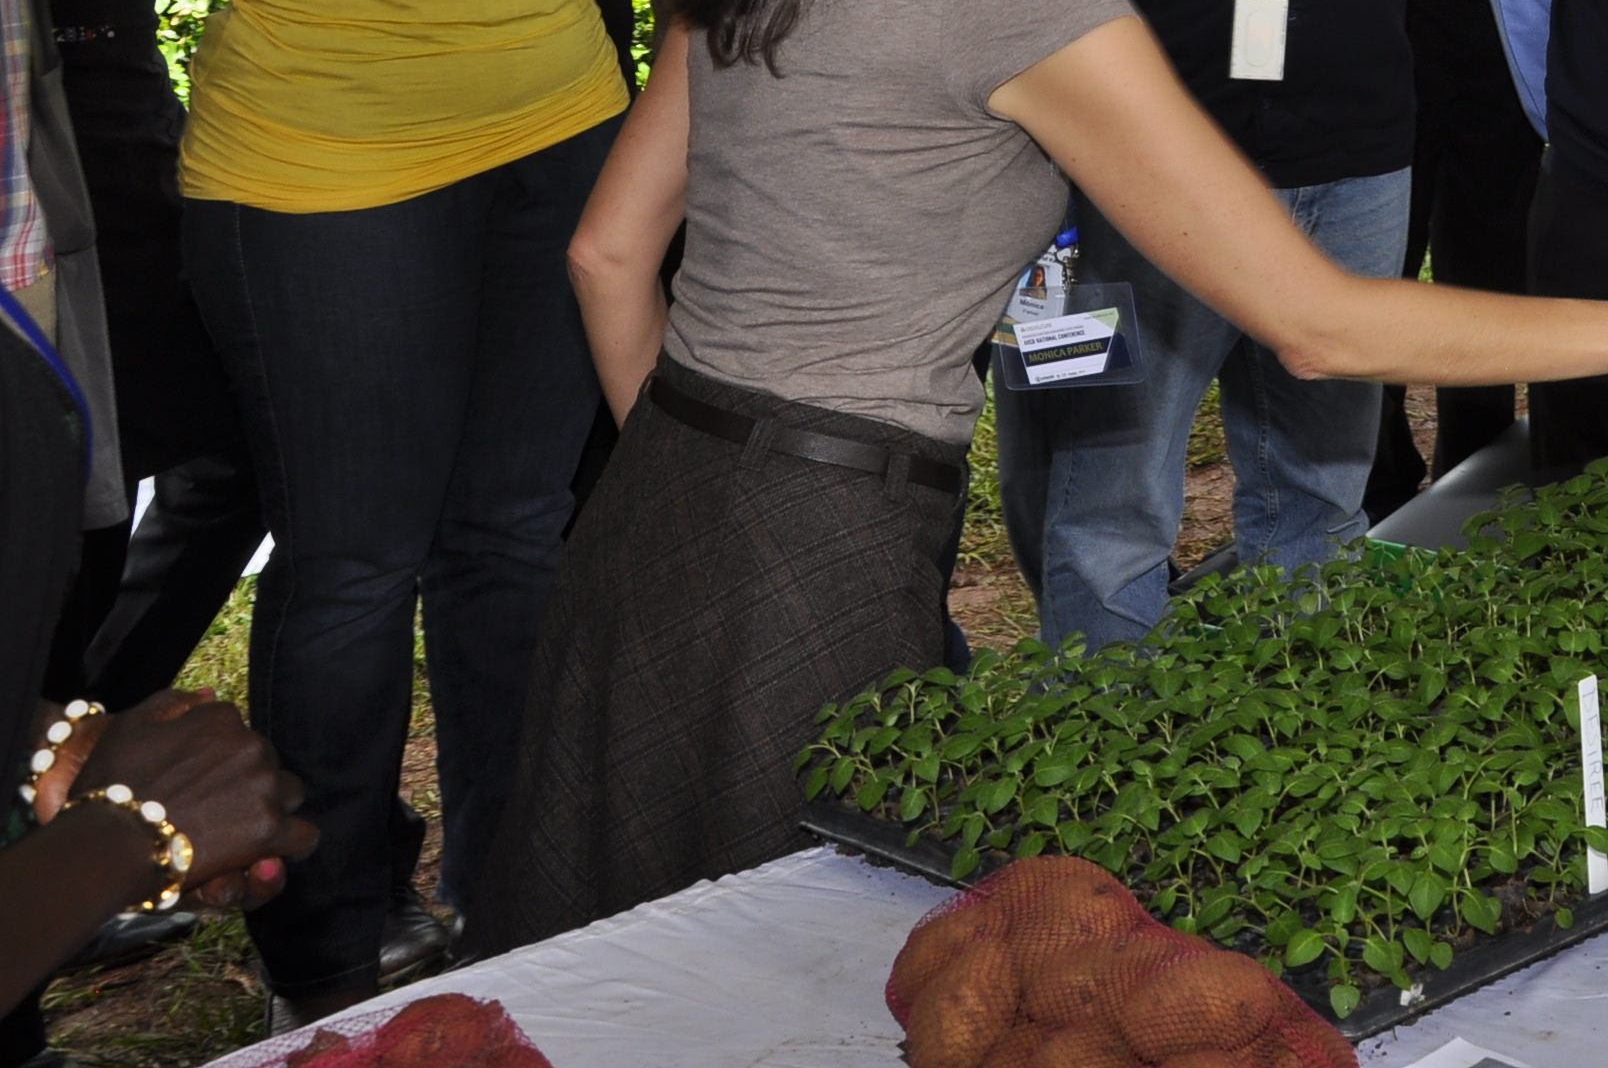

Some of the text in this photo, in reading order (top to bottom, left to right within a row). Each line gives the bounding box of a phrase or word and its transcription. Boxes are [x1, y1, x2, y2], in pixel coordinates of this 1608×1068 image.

[1020, 299, 1045, 310] Monica
[1036, 334, 1058, 343] NATIONAL
[1058, 329, 1085, 340] CONFERENCE
[1028, 341, 1104, 363] MONICA PARKER
[1582, 687, 1604, 814] DESIREE
